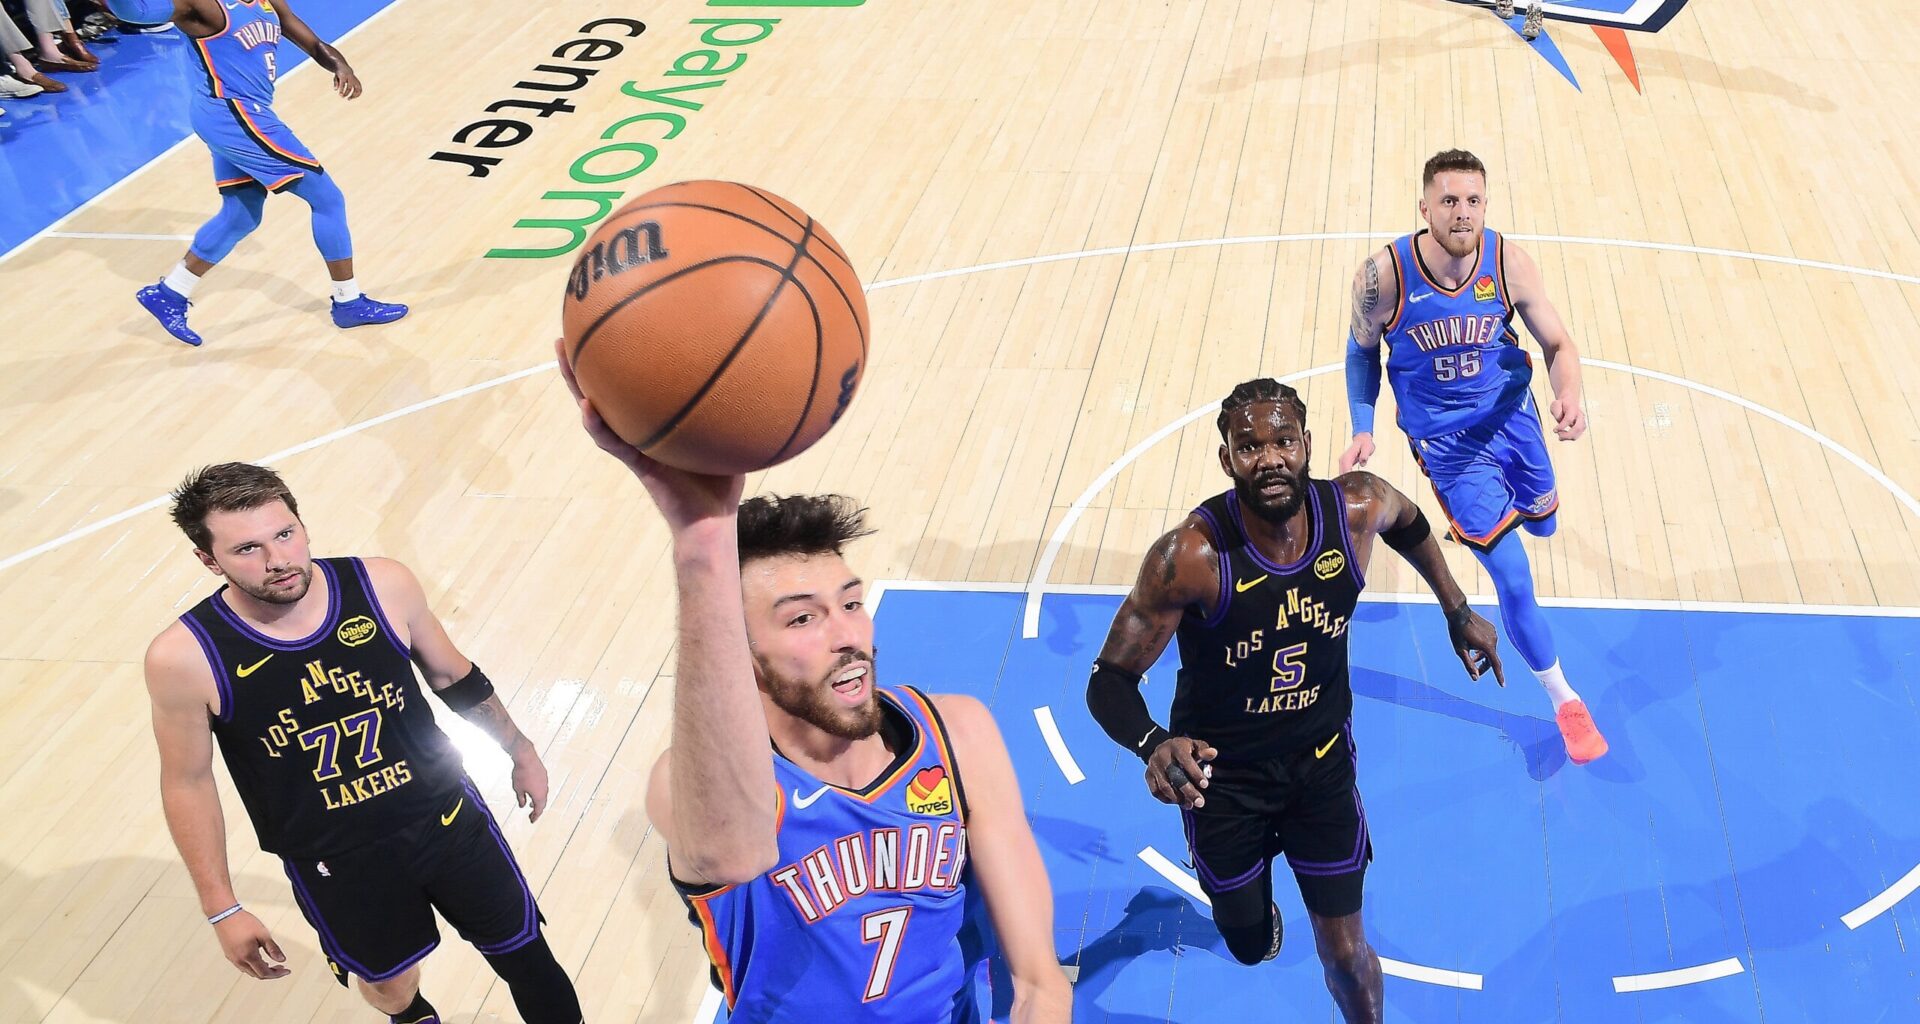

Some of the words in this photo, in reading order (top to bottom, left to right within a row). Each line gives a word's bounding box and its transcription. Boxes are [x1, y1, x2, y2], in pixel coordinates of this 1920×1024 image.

[233, 20, 281, 51] THUNDE
[263, 51, 277, 82] 5
[428, 17, 647, 179] center
[483, 18, 783, 259] paycom
[565, 220, 669, 302] Wil
[1433, 350, 1482, 382] 55
[1316, 556, 1343, 572] bibigo
[340, 622, 373, 640] bibigo
[1225, 630, 1264, 668] LOS
[1269, 641, 1308, 693] 5
[259, 708, 300, 758] LOS
[300, 659, 405, 713] ANGELES
[1244, 684, 1321, 714] LAKERS
[297, 707, 384, 782] 77
[320, 760, 412, 811] LAKERS
[860, 905, 914, 1004] 7
